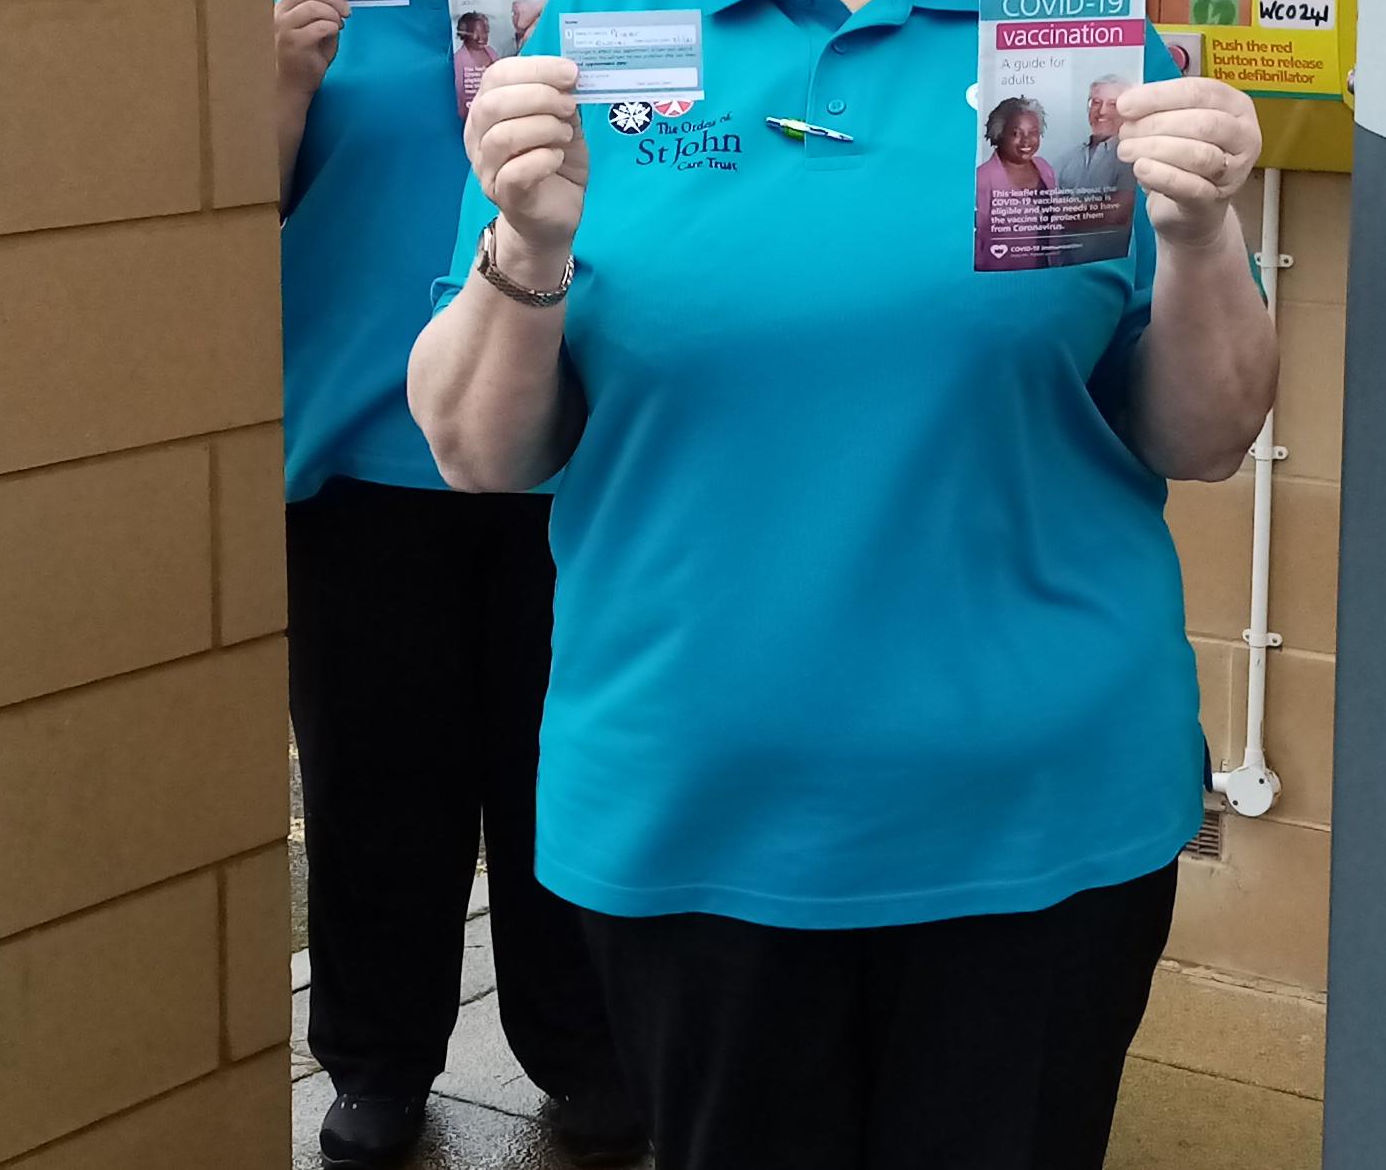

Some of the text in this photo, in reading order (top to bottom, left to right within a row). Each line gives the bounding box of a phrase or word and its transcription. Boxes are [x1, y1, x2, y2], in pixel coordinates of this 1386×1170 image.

[1002, 22, 1123, 46] vaccination
[1212, 39, 1293, 54] Push the red
[1001, 58, 1011, 69] A
[1014, 57, 1046, 71] guide
[1213, 53, 1324, 70] button to release
[1001, 73, 1036, 86] adults
[1214, 67, 1316, 85] the defibrillator
[636, 130, 743, 168] St John
[707, 157, 738, 172] Trust
[991, 198, 1032, 207] COVID-19
[991, 207, 1022, 217] eligible
[1024, 205, 1039, 215] and
[1041, 205, 1061, 214] who
[991, 216, 1006, 224] the
[991, 224, 1011, 233] from
